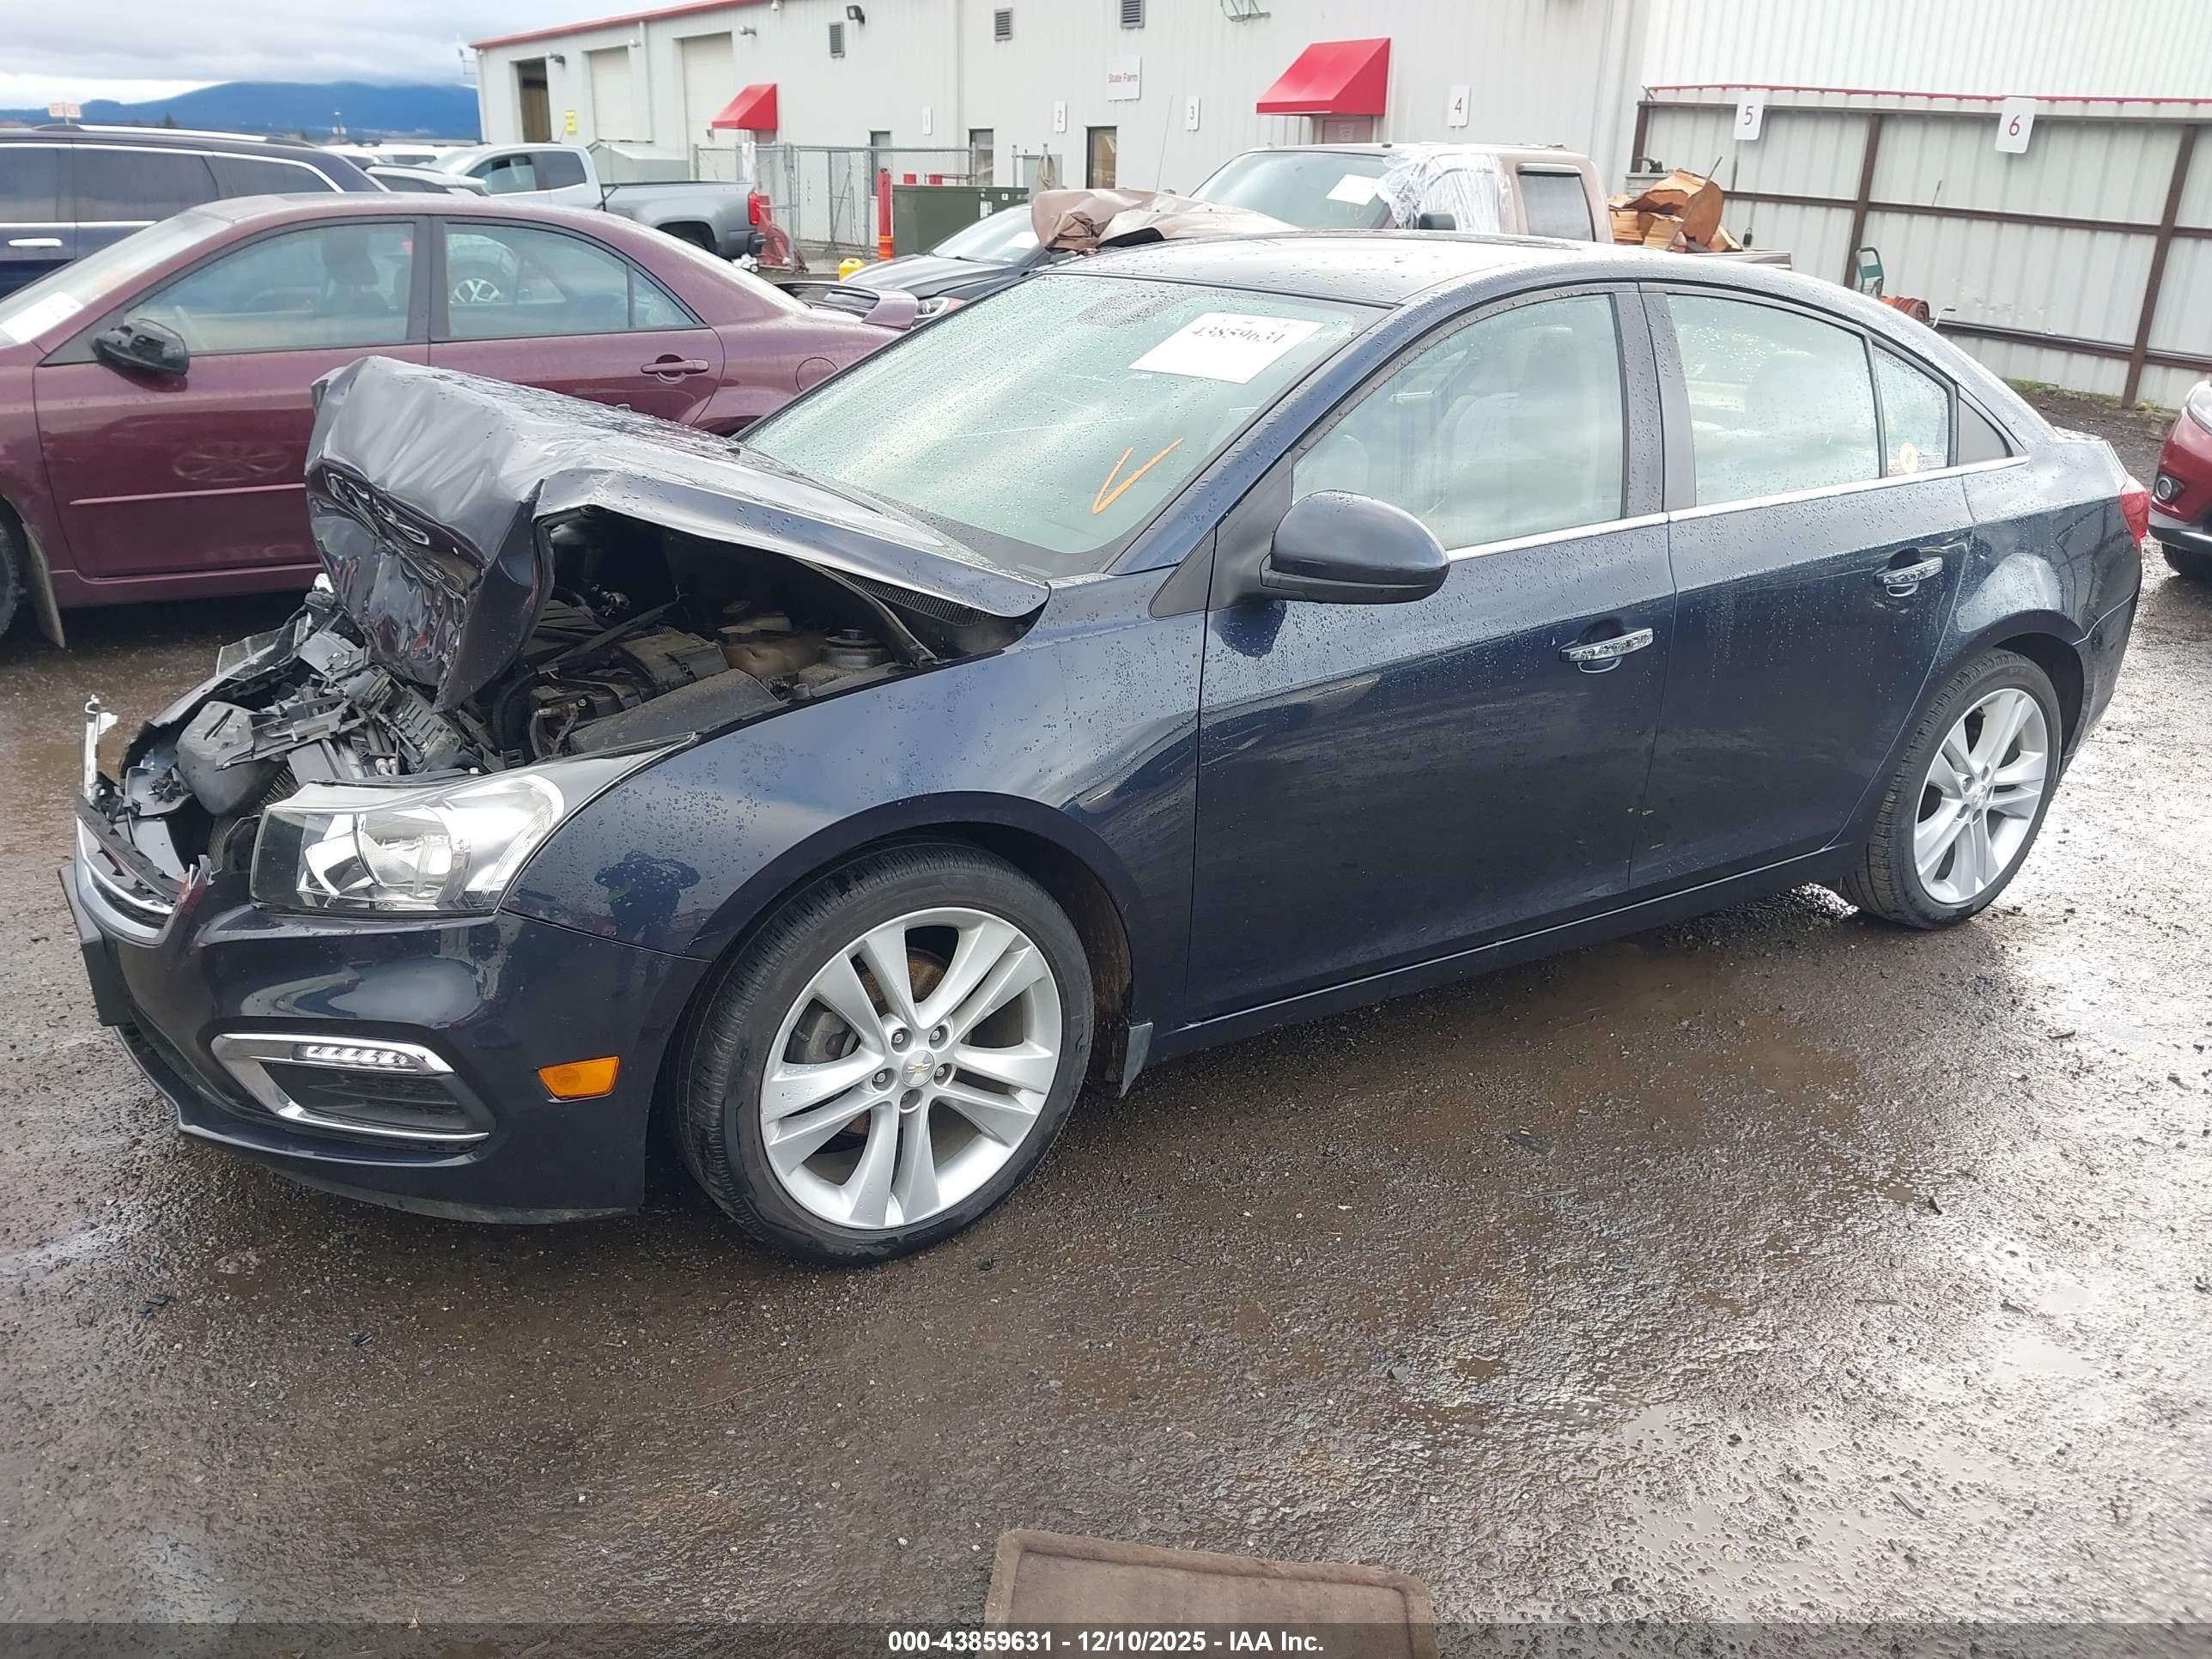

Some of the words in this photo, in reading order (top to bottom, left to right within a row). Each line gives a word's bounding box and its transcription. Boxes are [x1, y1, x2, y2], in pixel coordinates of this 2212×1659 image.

[1189, 105, 1194, 120] 3
[1455, 97, 1462, 114] 4
[1057, 110, 1063, 123] 2
[1744, 106, 1753, 125] 5
[2008, 114, 2020, 137] 6
